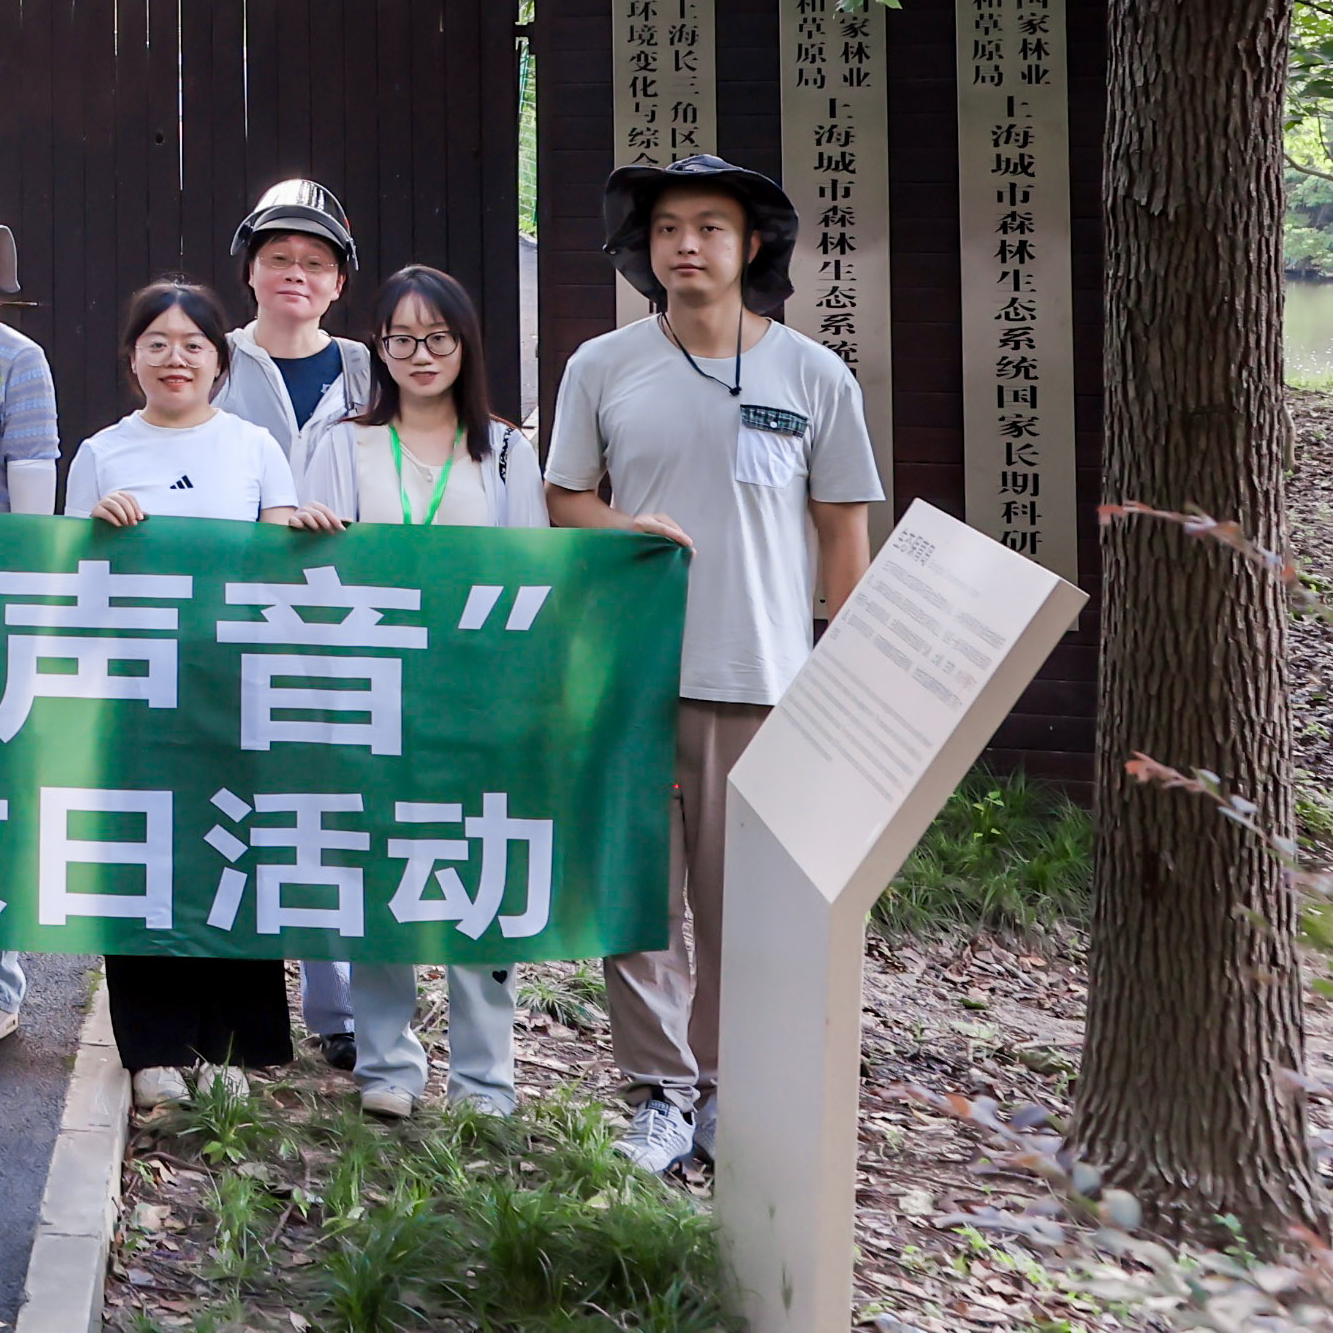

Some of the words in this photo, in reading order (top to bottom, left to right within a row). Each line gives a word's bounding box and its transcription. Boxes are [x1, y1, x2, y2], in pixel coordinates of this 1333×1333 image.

[813, 98, 859, 378] 上海城市森林生态系统
[990, 95, 1044, 555] 上海城市森林生态系统国家长期科研
